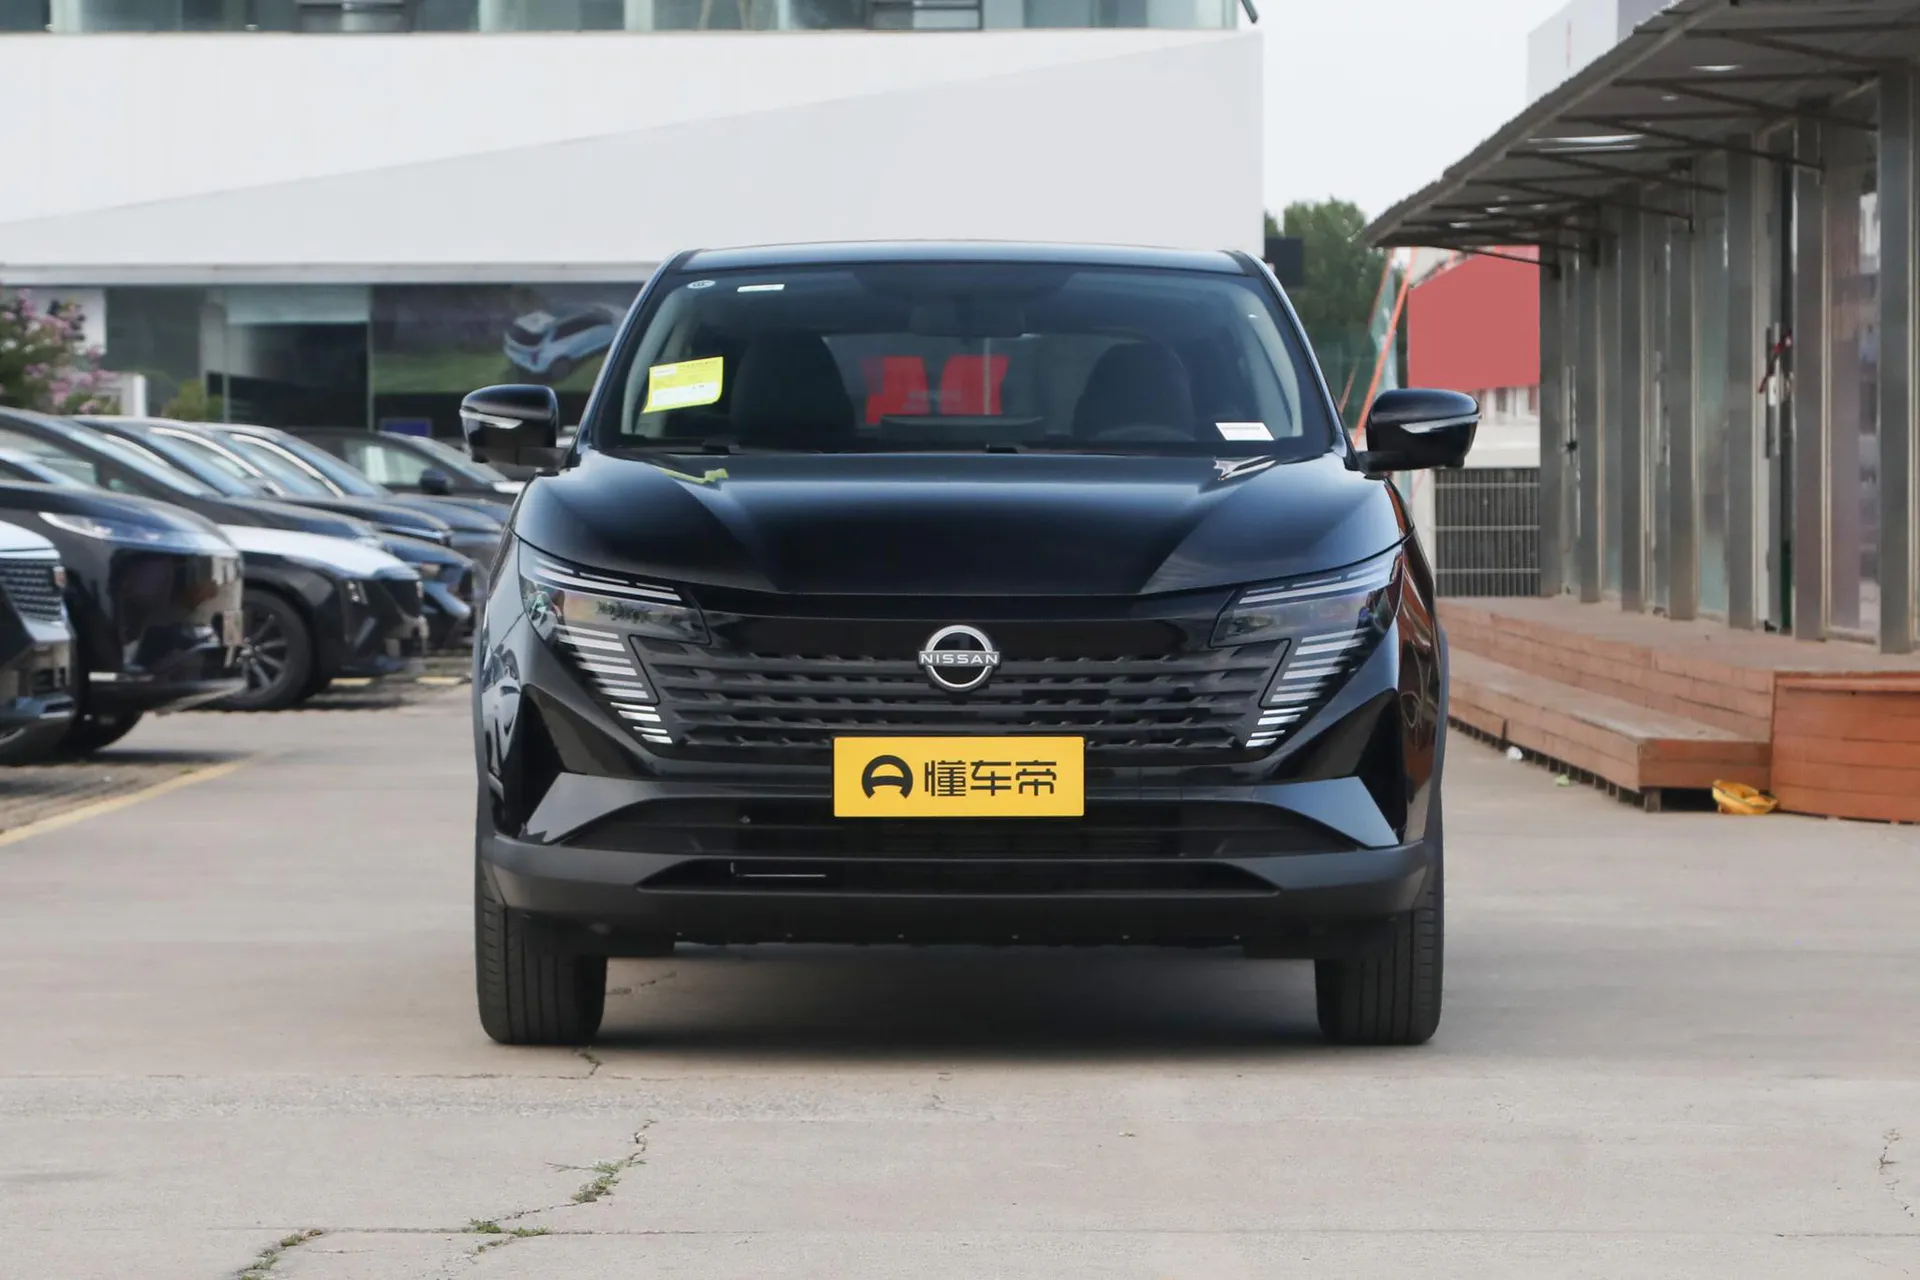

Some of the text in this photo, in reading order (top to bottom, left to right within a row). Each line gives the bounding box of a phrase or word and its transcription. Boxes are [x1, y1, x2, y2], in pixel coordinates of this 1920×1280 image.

[920, 653, 998, 665] NISSAN
[924, 760, 1057, 797] 懂车帝
